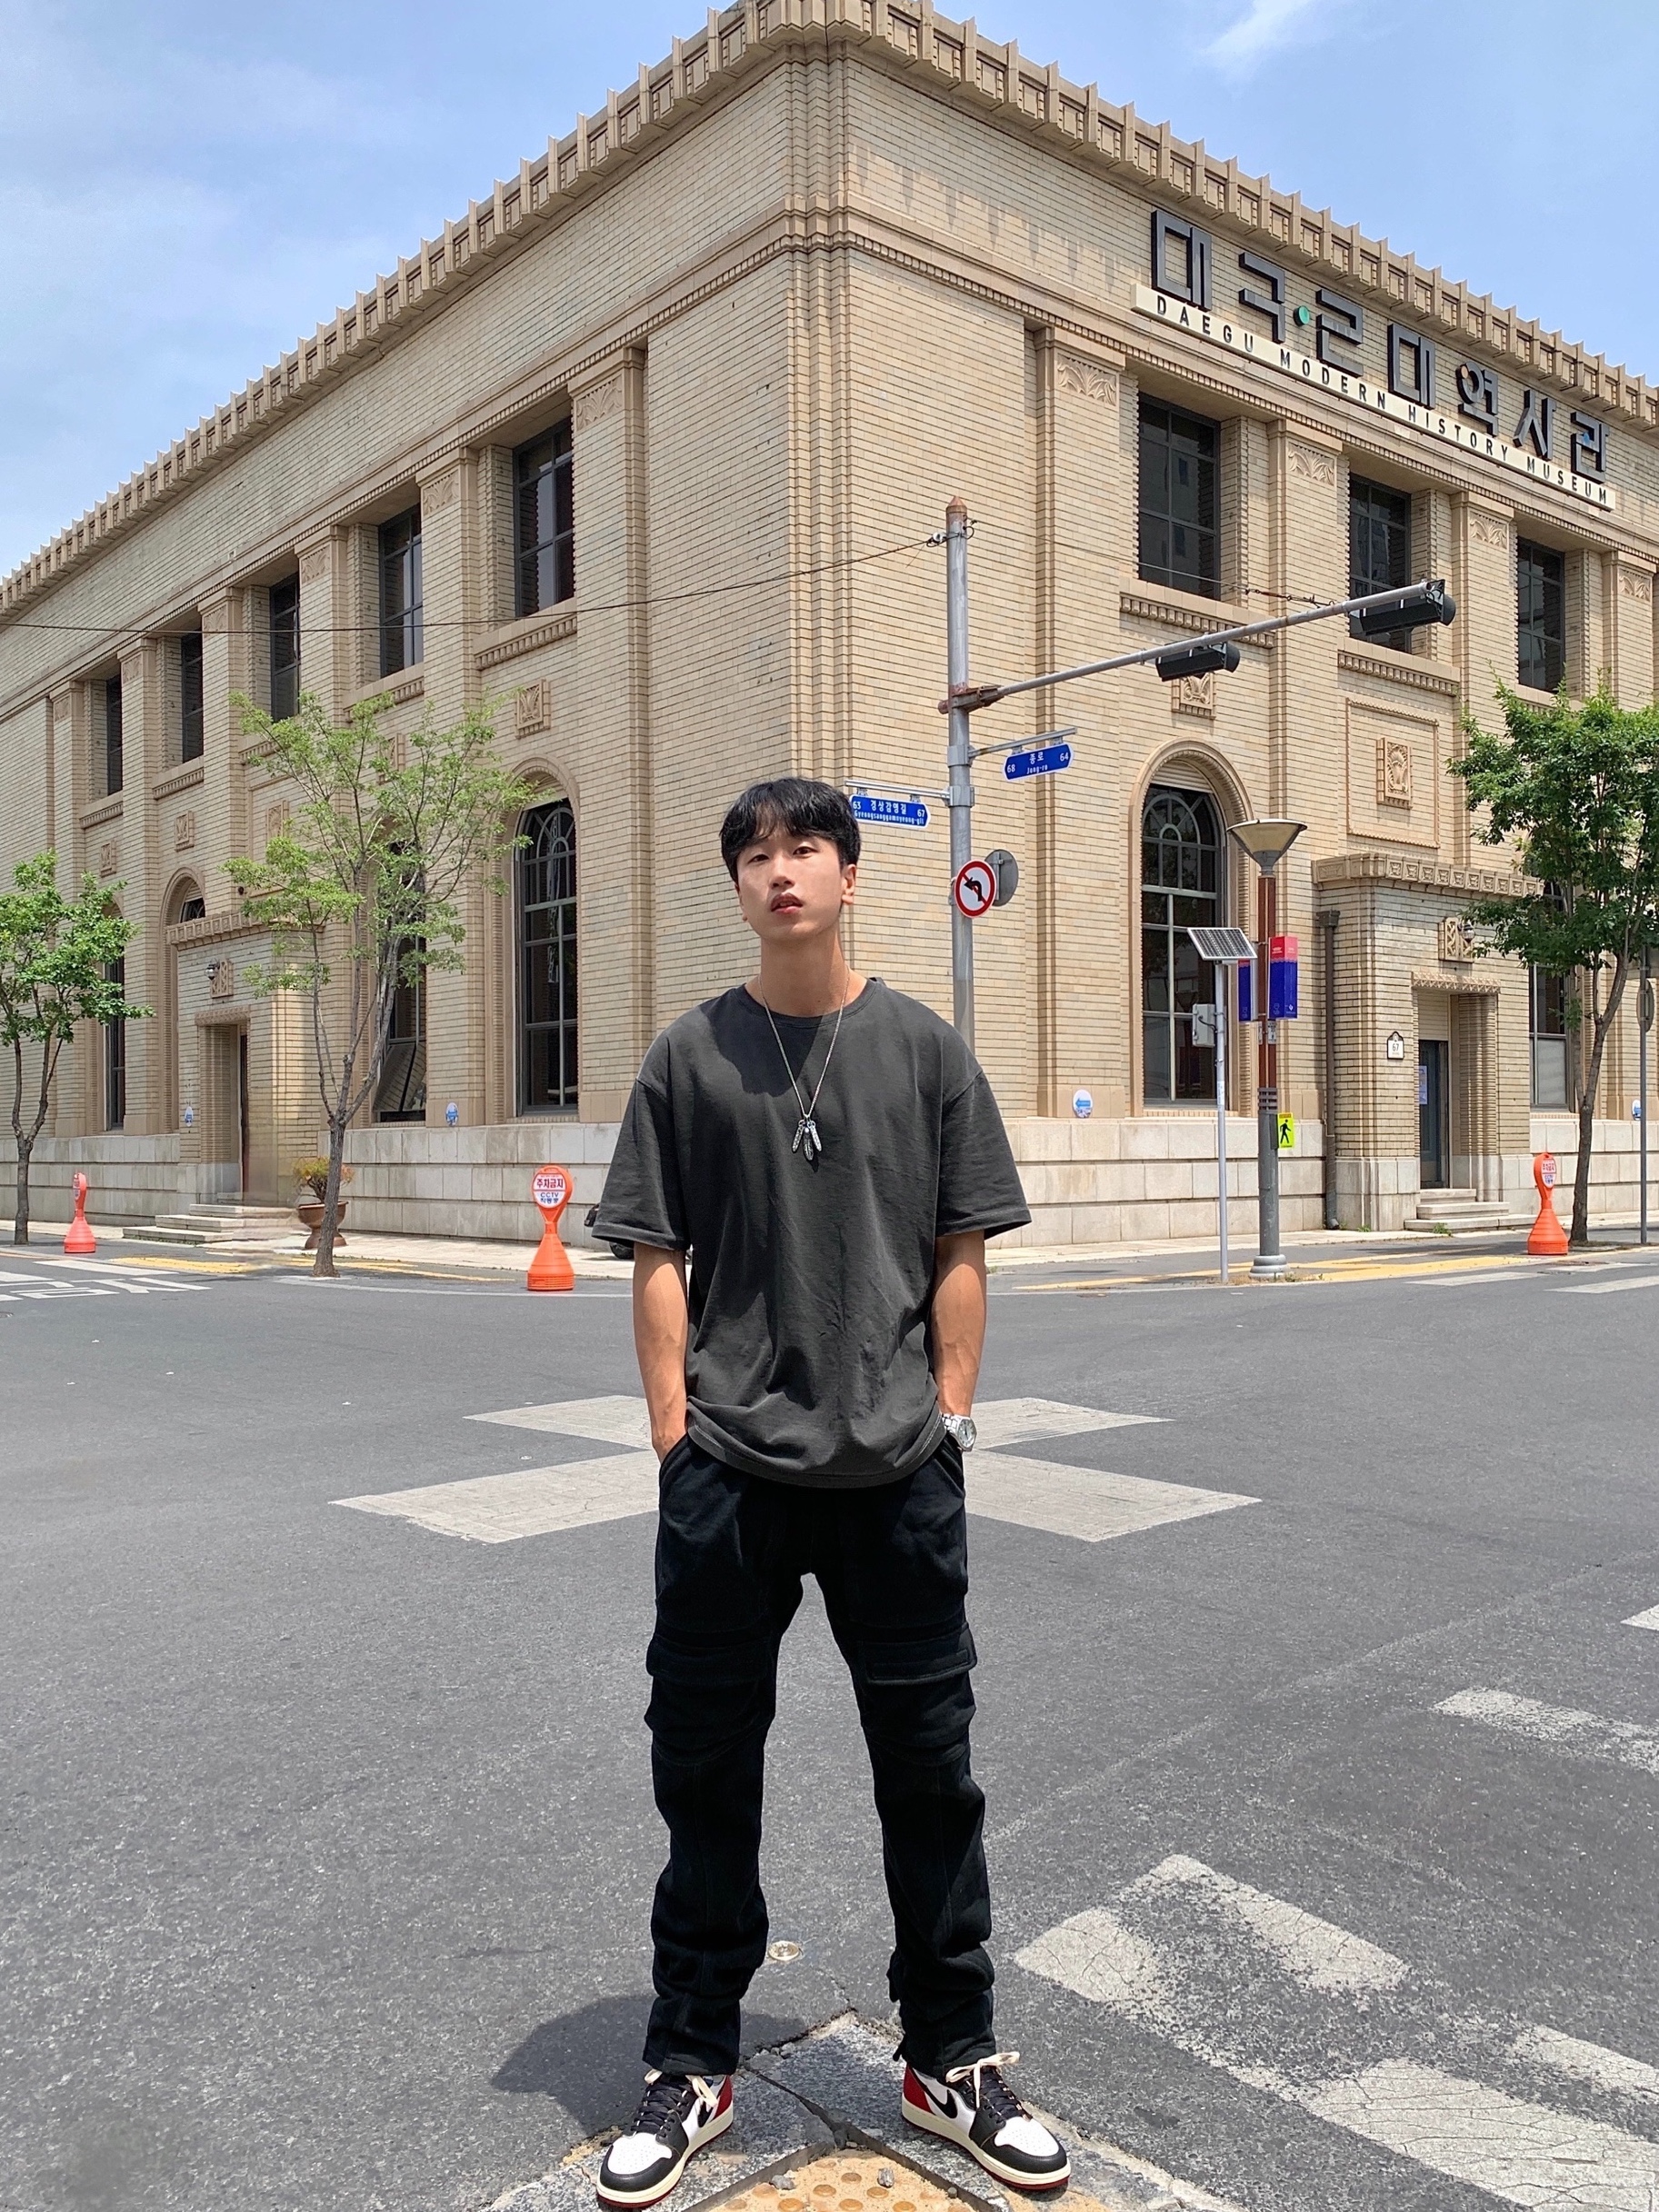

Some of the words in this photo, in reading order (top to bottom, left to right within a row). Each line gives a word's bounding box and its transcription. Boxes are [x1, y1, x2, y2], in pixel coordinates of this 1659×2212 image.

[1157, 294, 1254, 354] DAEGU
[1280, 348, 1385, 410] MODERN
[1408, 404, 1508, 462] HISTORY
[1526, 454, 1607, 504] MUSEUM
[1029, 751, 1044, 765] 종로
[1059, 752, 1069, 762] 64
[1006, 763, 1016, 773] 68
[1026, 764, 1048, 774] Jong-ro
[853, 801, 862, 810] 63
[870, 799, 907, 815] 경상감영길
[916, 809, 925, 818] 67
[1392, 1043, 1400, 1051] 67
[536, 1178, 564, 1188] 주차금지
